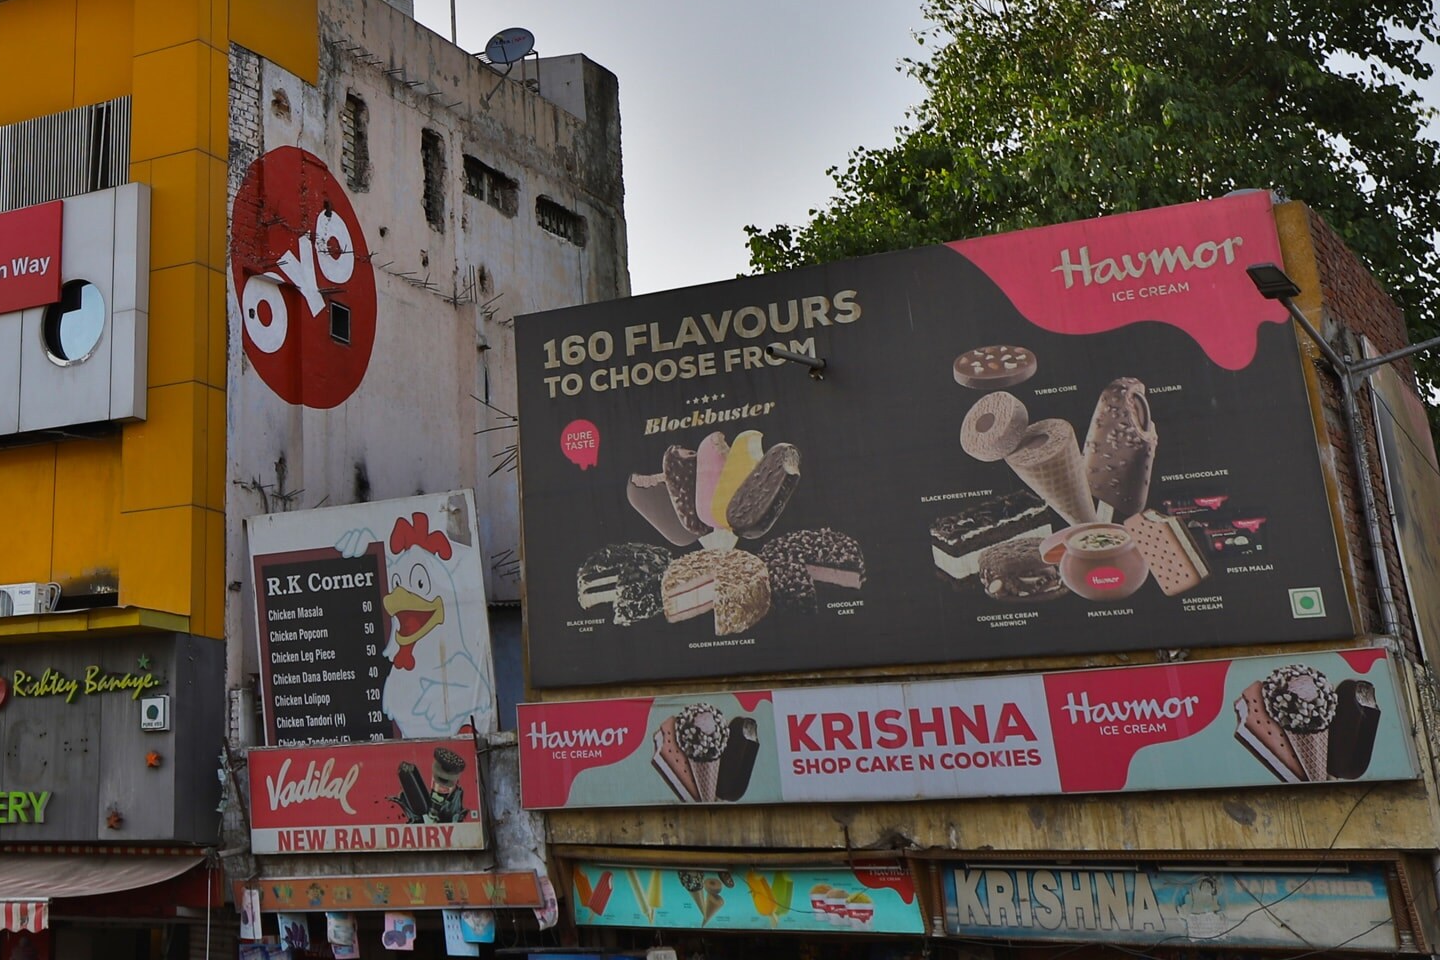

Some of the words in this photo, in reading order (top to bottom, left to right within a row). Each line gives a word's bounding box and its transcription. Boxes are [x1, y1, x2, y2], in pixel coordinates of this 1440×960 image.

[12, 256, 51, 277] Way
[1050, 236, 1243, 288] Havmor
[242, 209, 354, 354] OYO
[1112, 290, 1135, 302] ICE
[1139, 282, 1190, 298] CREAM
[543, 330, 613, 370] 160
[625, 290, 862, 356] FLAVOURS
[543, 372, 583, 399] TO
[589, 352, 717, 392] CHOOSE
[723, 337, 816, 373] FROM
[1034, 387, 1058, 396] TURBO
[1058, 385, 1077, 393] CONE
[1149, 385, 1182, 394] ZULUBAR
[644, 400, 776, 436] Blockbuster
[565, 439, 595, 451] TASTE
[566, 430, 593, 441] PURE
[1161, 474, 1184, 482] SWISS
[1185, 469, 1229, 480] CHOCOLATE
[921, 495, 942, 503] BLACK
[942, 493, 967, 501] FOREST
[968, 489, 993, 498] PASTRY
[1226, 566, 1248, 574] PISTA
[1249, 564, 1274, 572] MALAI
[266, 575, 303, 596] R.K
[308, 571, 374, 592] Corner
[827, 600, 864, 609] CHOCOLATE
[1182, 596, 1223, 604] SANDWICH
[1184, 604, 1196, 612] ICE
[1196, 602, 1224, 611] CREAM
[268, 607, 296, 621] Chicken
[297, 606, 323, 618] Masala
[362, 600, 372, 613] 60
[838, 608, 855, 616] CAKE
[976, 614, 1002, 622] COOKIE
[1014, 611, 1039, 619] CREAM
[1112, 608, 1134, 616] KULFI
[584, 618, 606, 626] FOREST
[990, 620, 1027, 628] SANDWICH
[270, 630, 297, 642] Chicken
[299, 628, 328, 642] Popcorn
[364, 622, 375, 635] 50
[688, 641, 712, 649] GOLDEN
[712, 639, 739, 648] FANTASY
[739, 638, 756, 646] CAKE
[271, 651, 299, 664] Chicken
[300, 650, 314, 663] Leg
[315, 648, 336, 660] Piece
[366, 644, 376, 656] 50
[13, 667, 78, 703] Rishtey
[273, 672, 301, 685] Chicken
[302, 671, 321, 683] Dana
[322, 669, 356, 682] Boneless
[368, 666, 378, 679] 40
[274, 693, 302, 707] Chicken
[304, 693, 330, 707] Lolipop
[366, 688, 380, 700] 120
[1061, 691, 1199, 724] Havmor
[276, 715, 304, 729] Chicken
[305, 713, 333, 727] Tandori
[334, 713, 346, 727] (H)
[368, 711, 382, 723] 120
[786, 702, 1038, 752] KRISHNA
[1100, 726, 1120, 736] ICE
[1124, 723, 1167, 734] CREAM
[526, 721, 628, 750] Havmor
[552, 751, 567, 760] ICE
[569, 749, 603, 760] CREAM
[793, 757, 855, 776] SHOP
[856, 754, 915, 774] CAKE
[919, 753, 936, 771] N
[940, 748, 1042, 770] COOKIES
[266, 757, 359, 815] Vadilal
[277, 828, 327, 851] NEW
[334, 827, 376, 850] RAJ
[385, 825, 454, 849] DAIRY
[1235, 878, 1278, 894] PAN
[1285, 878, 1376, 897] CORNER
[954, 868, 1167, 931] KRISHNA
